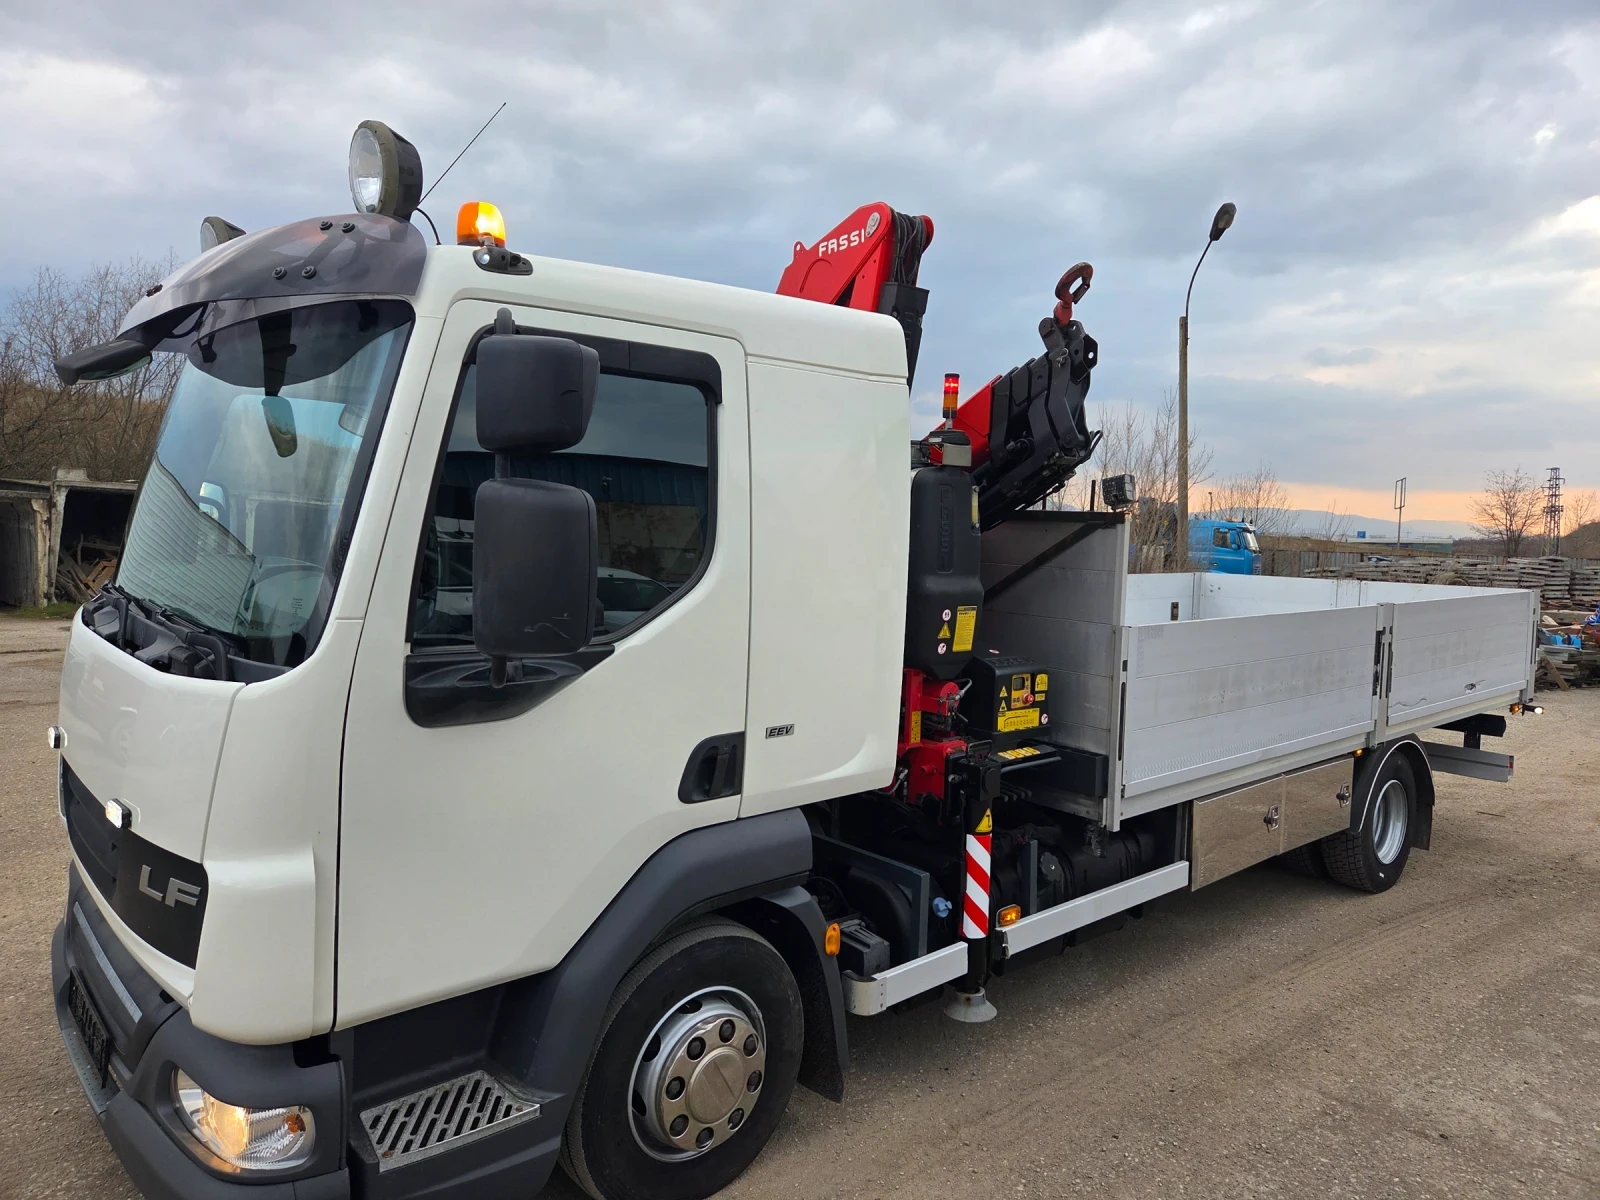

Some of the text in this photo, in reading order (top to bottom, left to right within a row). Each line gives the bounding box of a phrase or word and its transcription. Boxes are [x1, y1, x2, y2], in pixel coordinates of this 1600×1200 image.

[818, 228, 865, 257] FASSI
[768, 725, 793, 737] EEV
[139, 864, 201, 908] LF
